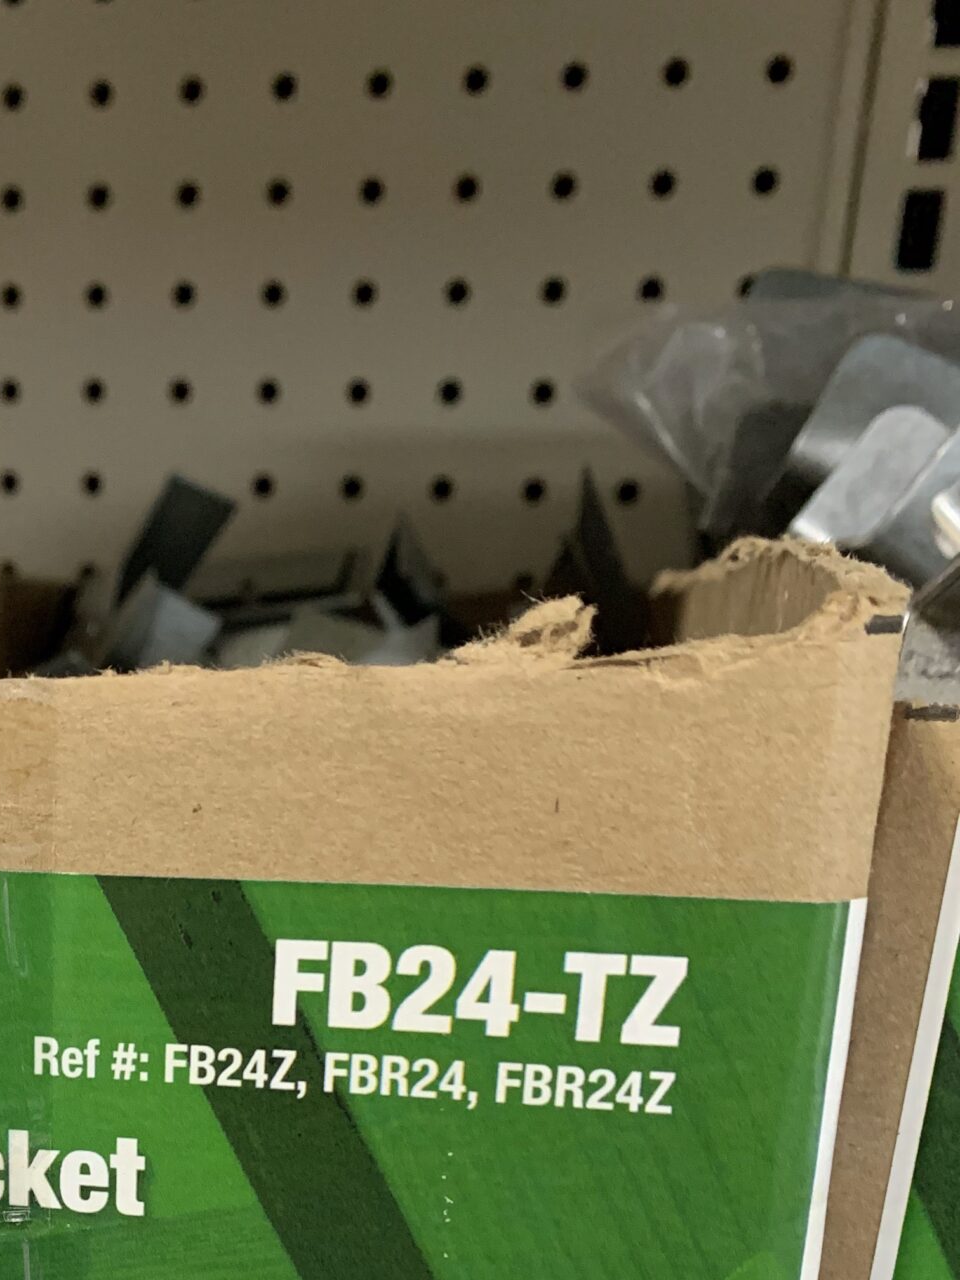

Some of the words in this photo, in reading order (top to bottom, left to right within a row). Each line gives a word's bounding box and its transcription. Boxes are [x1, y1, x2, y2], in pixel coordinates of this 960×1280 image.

[272, 938, 689, 1047] FB24-TZ
[33, 1035, 100, 1078] Ref
[111, 1042, 149, 1082] #:
[164, 1043, 307, 1099] FB24Z,
[323, 1052, 478, 1110] FBR24,
[495, 1062, 676, 1114] FBR24Z
